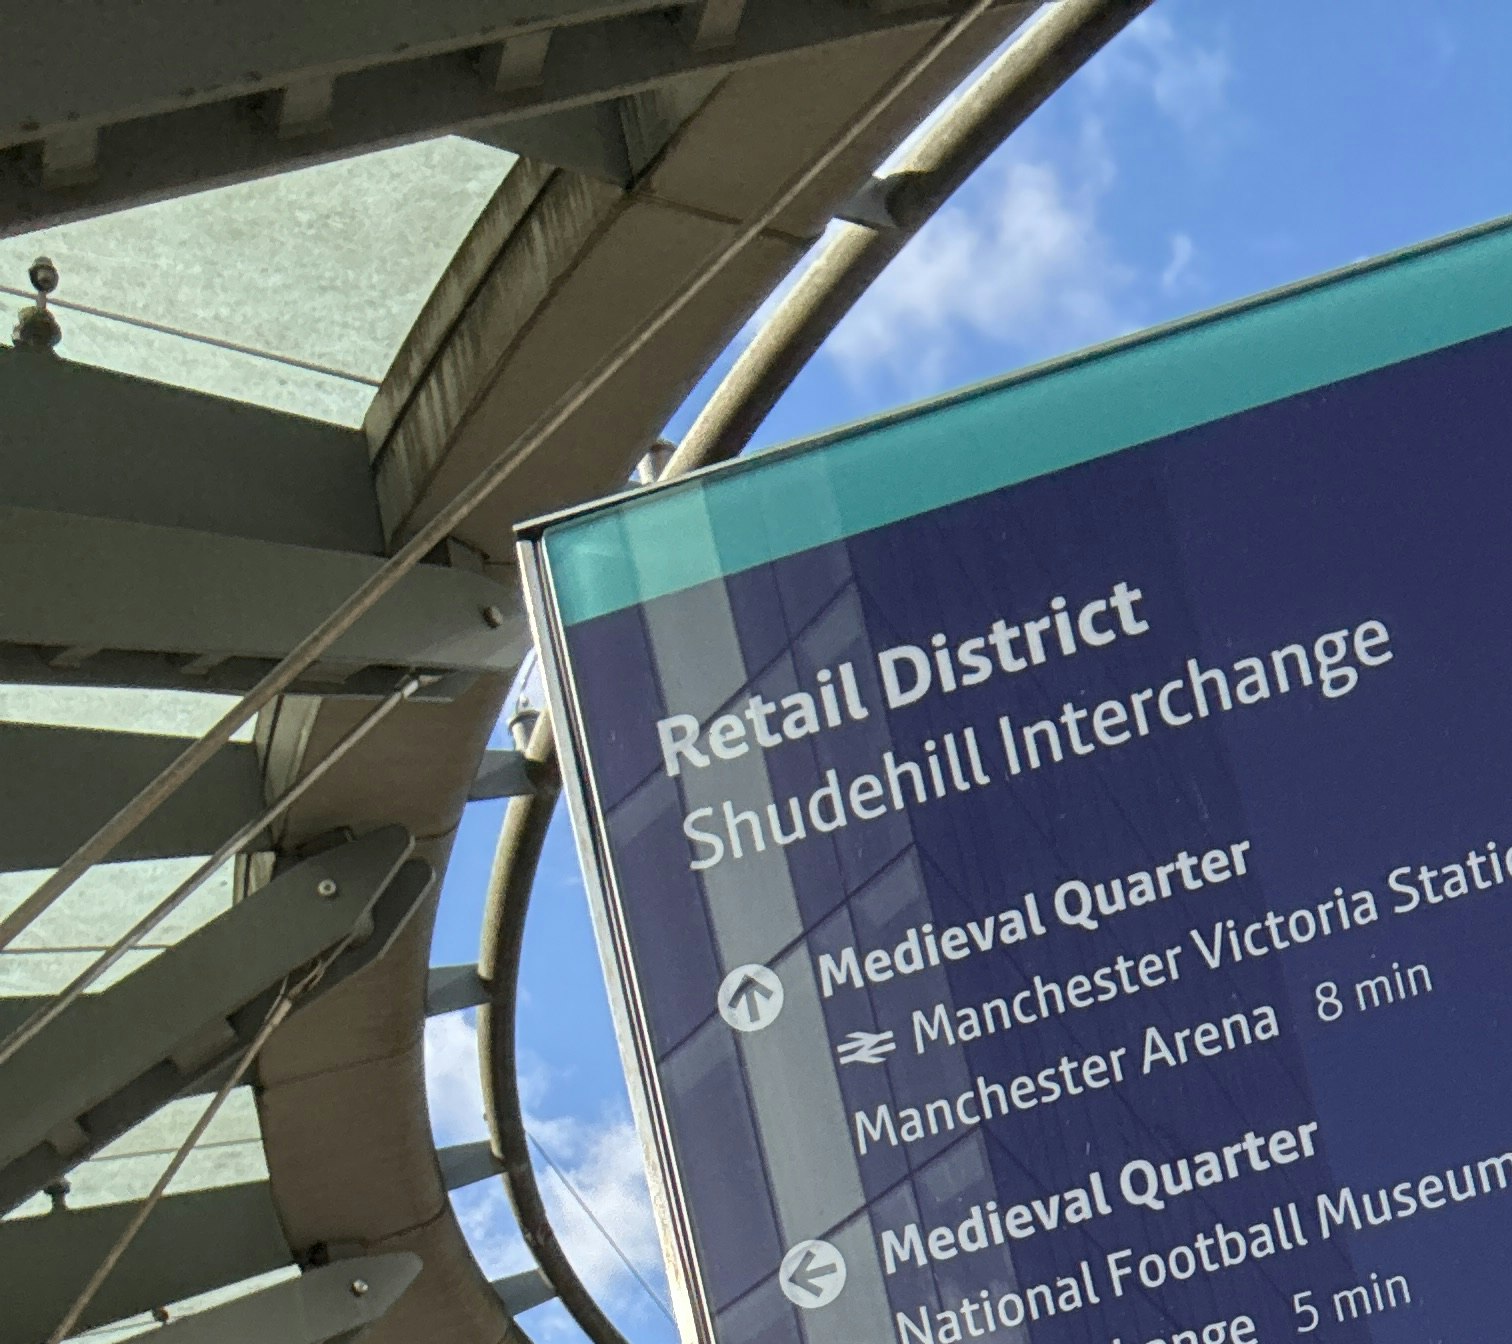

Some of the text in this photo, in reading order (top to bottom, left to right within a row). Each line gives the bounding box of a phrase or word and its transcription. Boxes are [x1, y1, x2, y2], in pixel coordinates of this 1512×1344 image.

[658, 581, 1150, 777] Retail District
[683, 618, 1394, 871] Shudehill Interchange
[817, 836, 1252, 998] Medieval Quarter
[911, 941, 1182, 1055] Manchester
[1192, 886, 1378, 969] Victoria
[854, 958, 1433, 1155] Manchester Arena 8 min
[881, 1115, 1319, 1276] Medieval Quarter
[1107, 1202, 1308, 1299] Football
[1293, 1291, 1319, 1333] 5
[1333, 1271, 1412, 1325] min
